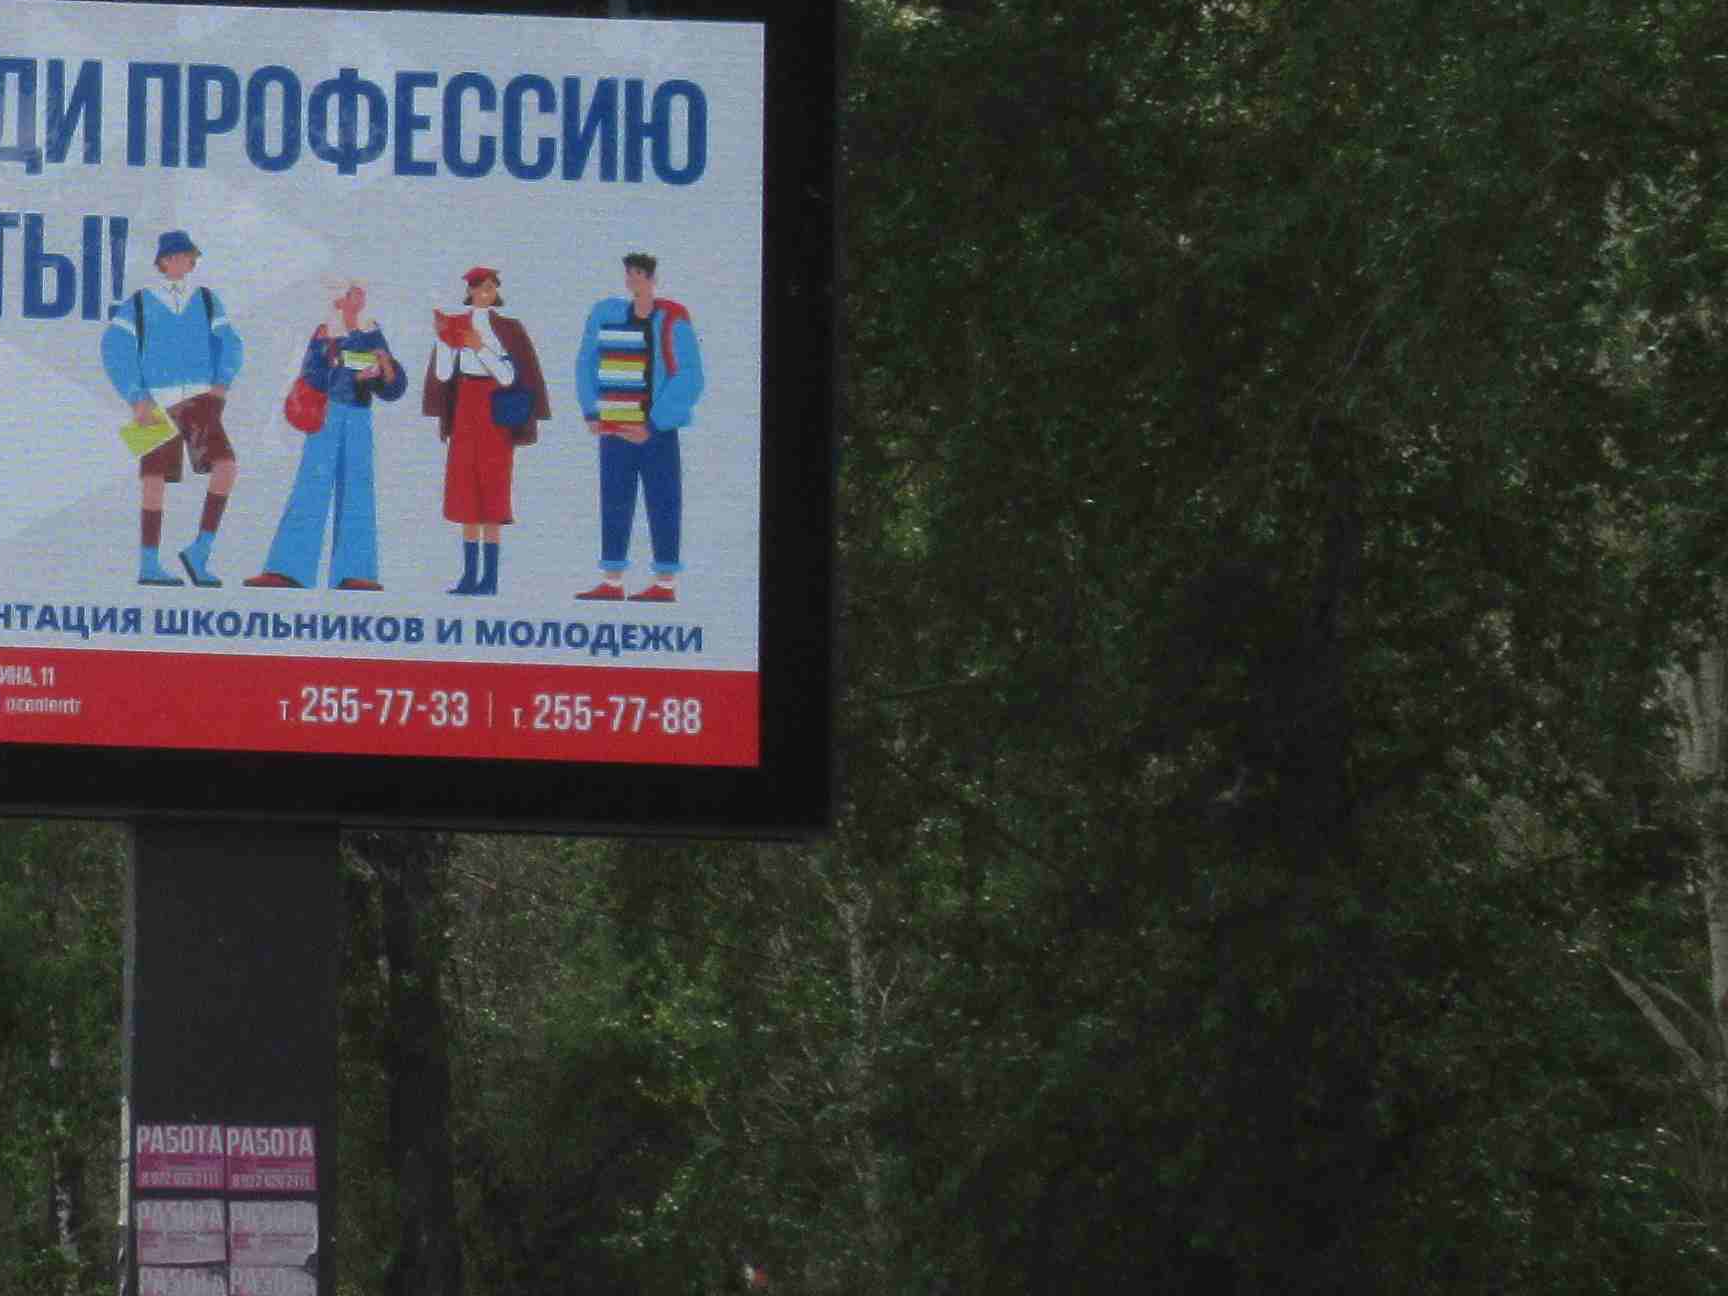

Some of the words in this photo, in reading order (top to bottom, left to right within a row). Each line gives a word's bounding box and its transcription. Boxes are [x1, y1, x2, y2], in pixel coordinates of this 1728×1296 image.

[126, 61, 709, 186] ПРОФЕССИЮ
[154, 607, 425, 644] ШКОЛЬНИКОВ
[436, 617, 463, 646] И
[475, 619, 704, 657] МОЛОДЕЖИ
[40, 666, 55, 687] 11
